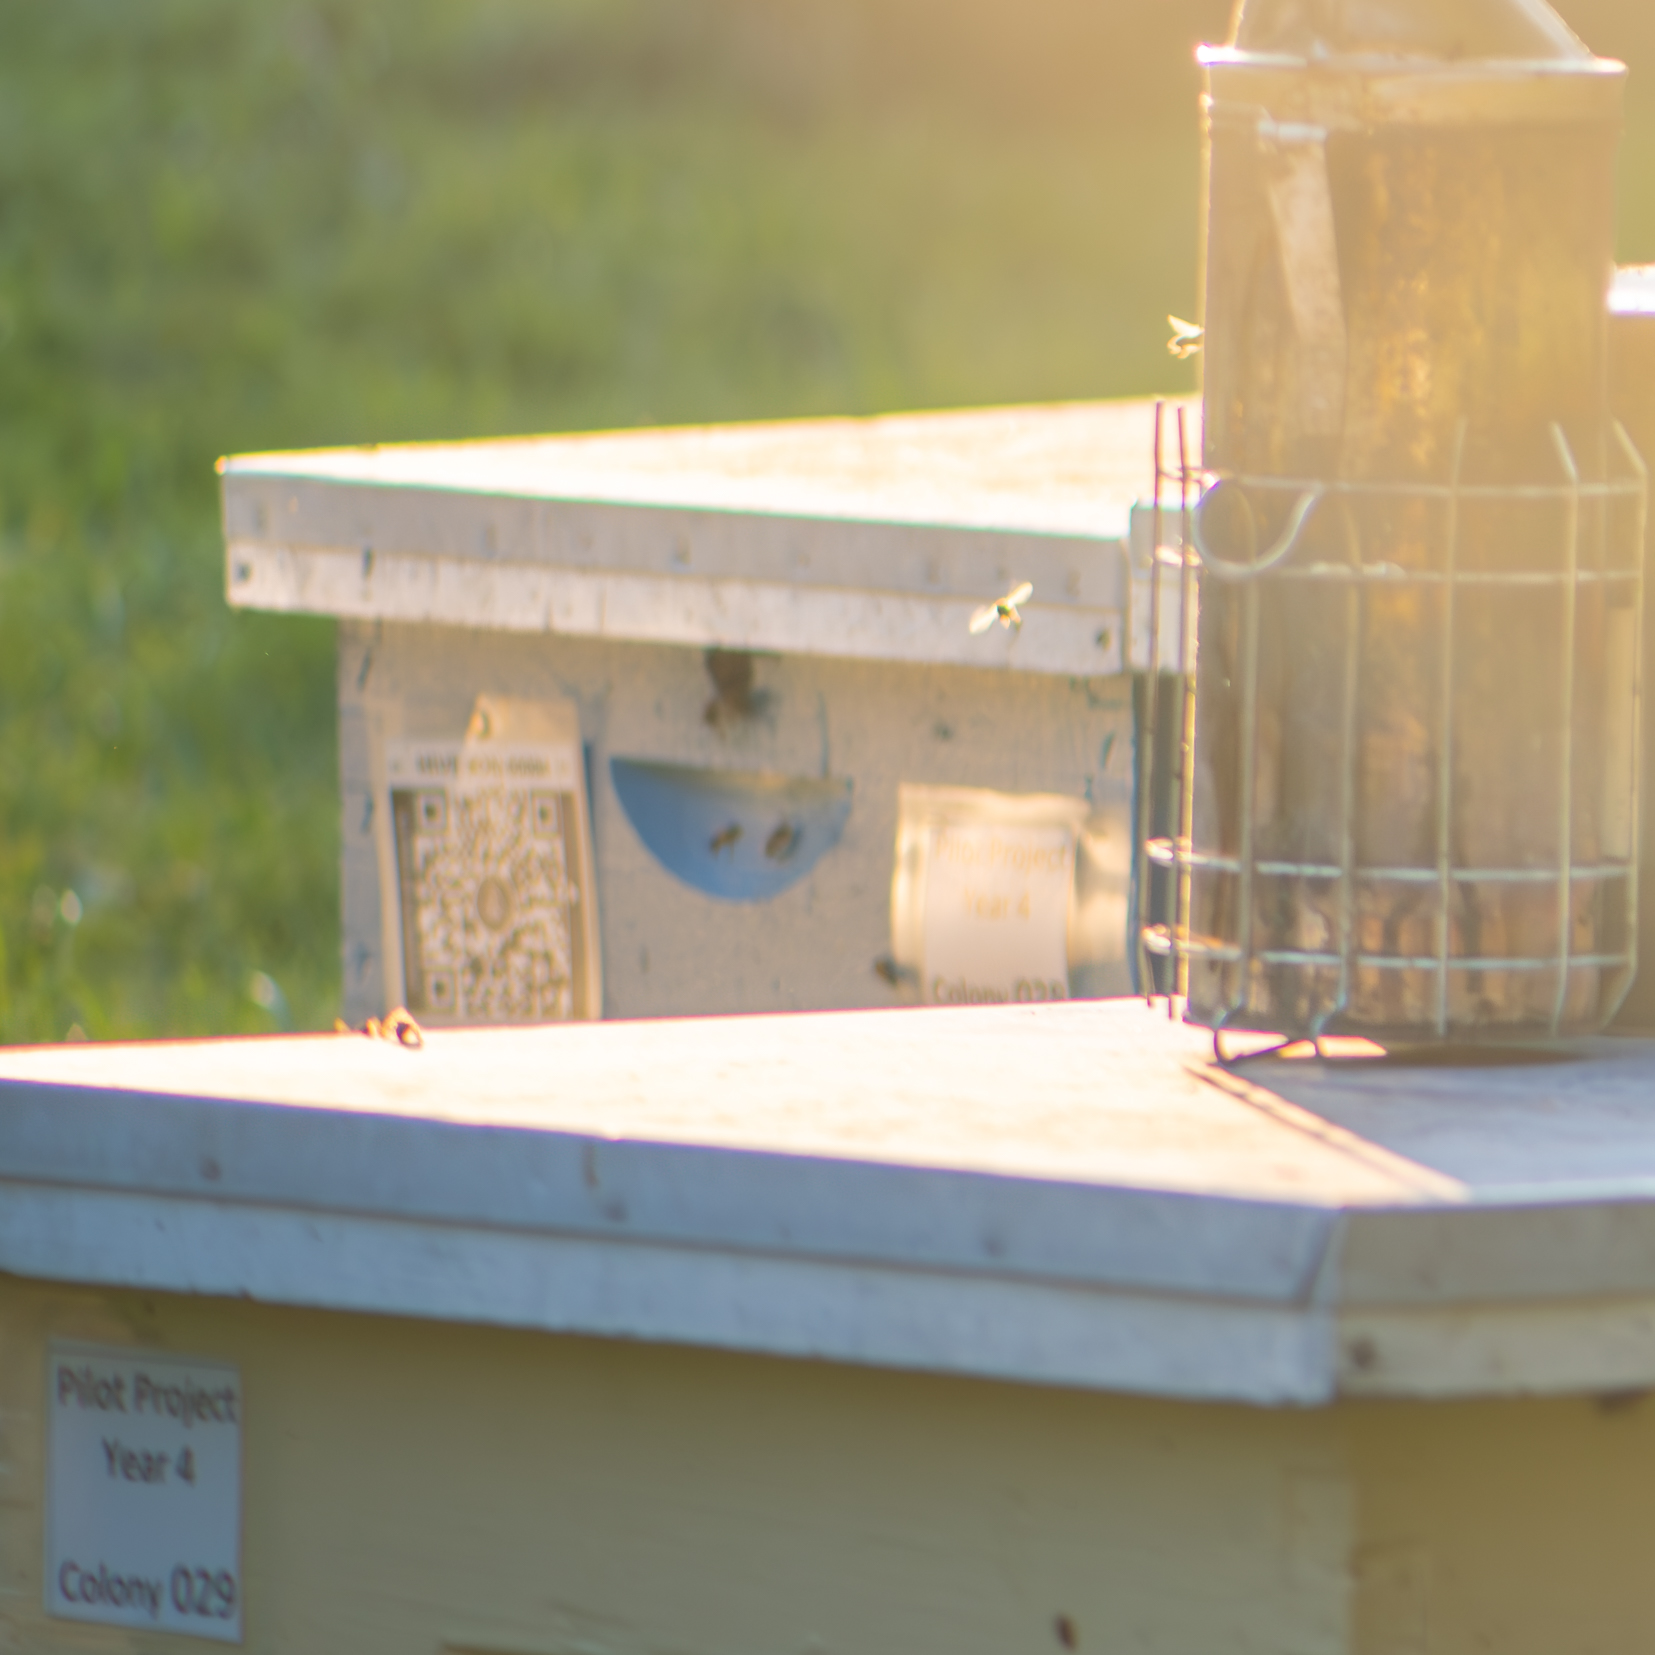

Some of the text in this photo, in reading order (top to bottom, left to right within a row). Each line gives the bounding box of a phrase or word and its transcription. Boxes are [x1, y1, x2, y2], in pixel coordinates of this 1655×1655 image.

[964, 886, 1009, 921] Year
[57, 1365, 237, 1429] Pilot Project
[101, 1437, 196, 1487] Year 4
[59, 1560, 236, 1621] Colony 029
